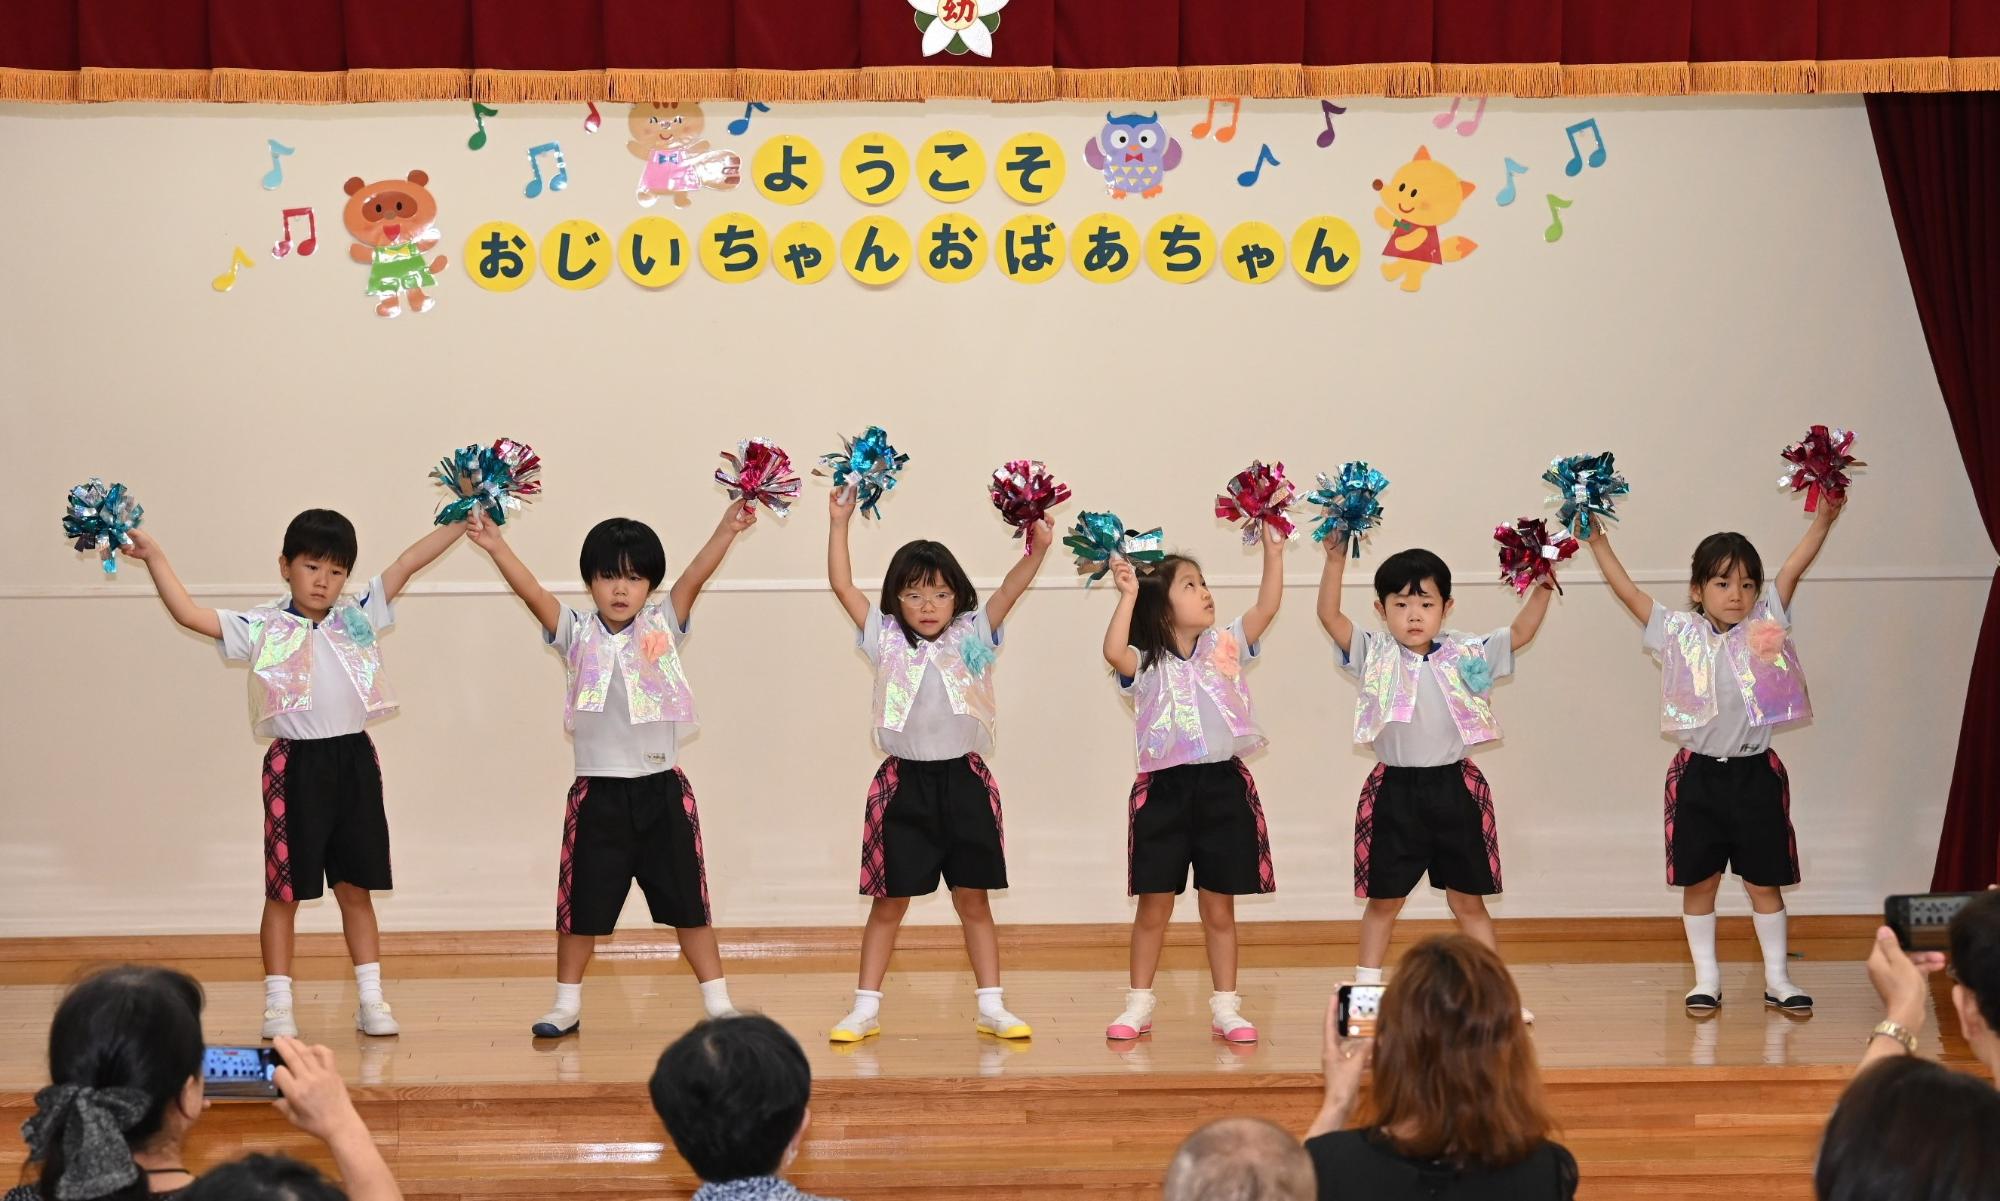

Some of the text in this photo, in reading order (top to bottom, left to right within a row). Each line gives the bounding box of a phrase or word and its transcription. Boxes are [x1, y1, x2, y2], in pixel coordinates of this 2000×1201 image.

[942, 0, 975, 23] 幼
[764, 143, 1051, 195] ようこそ
[479, 223, 1350, 281] おじいちゃんおばあちゃん
